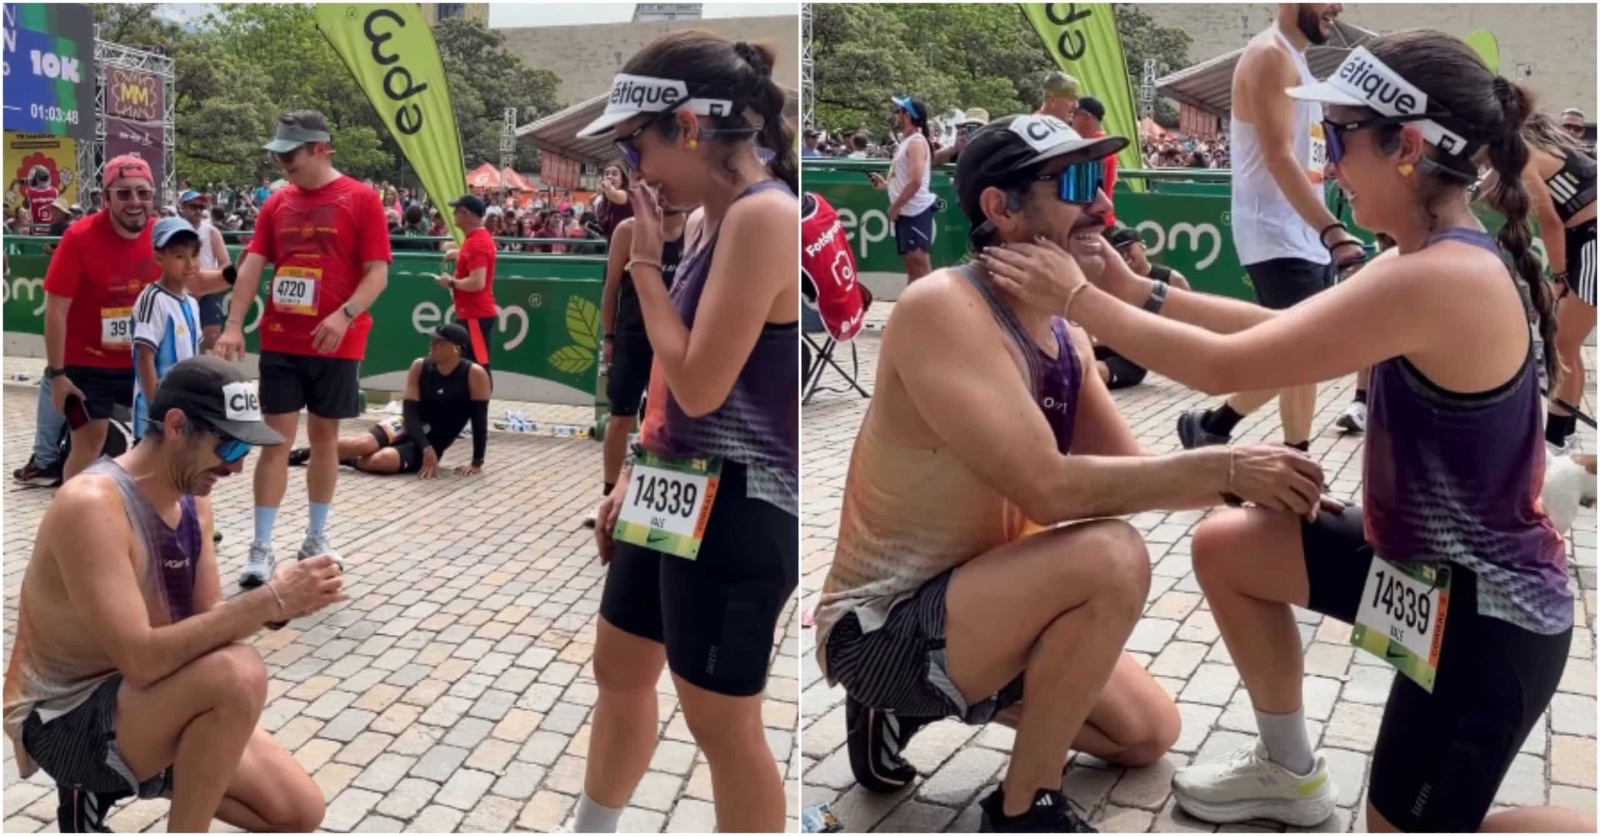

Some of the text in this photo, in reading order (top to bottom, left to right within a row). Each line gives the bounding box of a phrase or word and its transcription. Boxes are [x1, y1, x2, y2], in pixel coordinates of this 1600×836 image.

[30, 49, 81, 83] 10K
[363, 9, 427, 135] epm
[30, 103, 79, 125] 01:03:48
[277, 280, 306, 298] 4720
[633, 474, 698, 518] 14339
[1372, 569, 1431, 636] 14339
